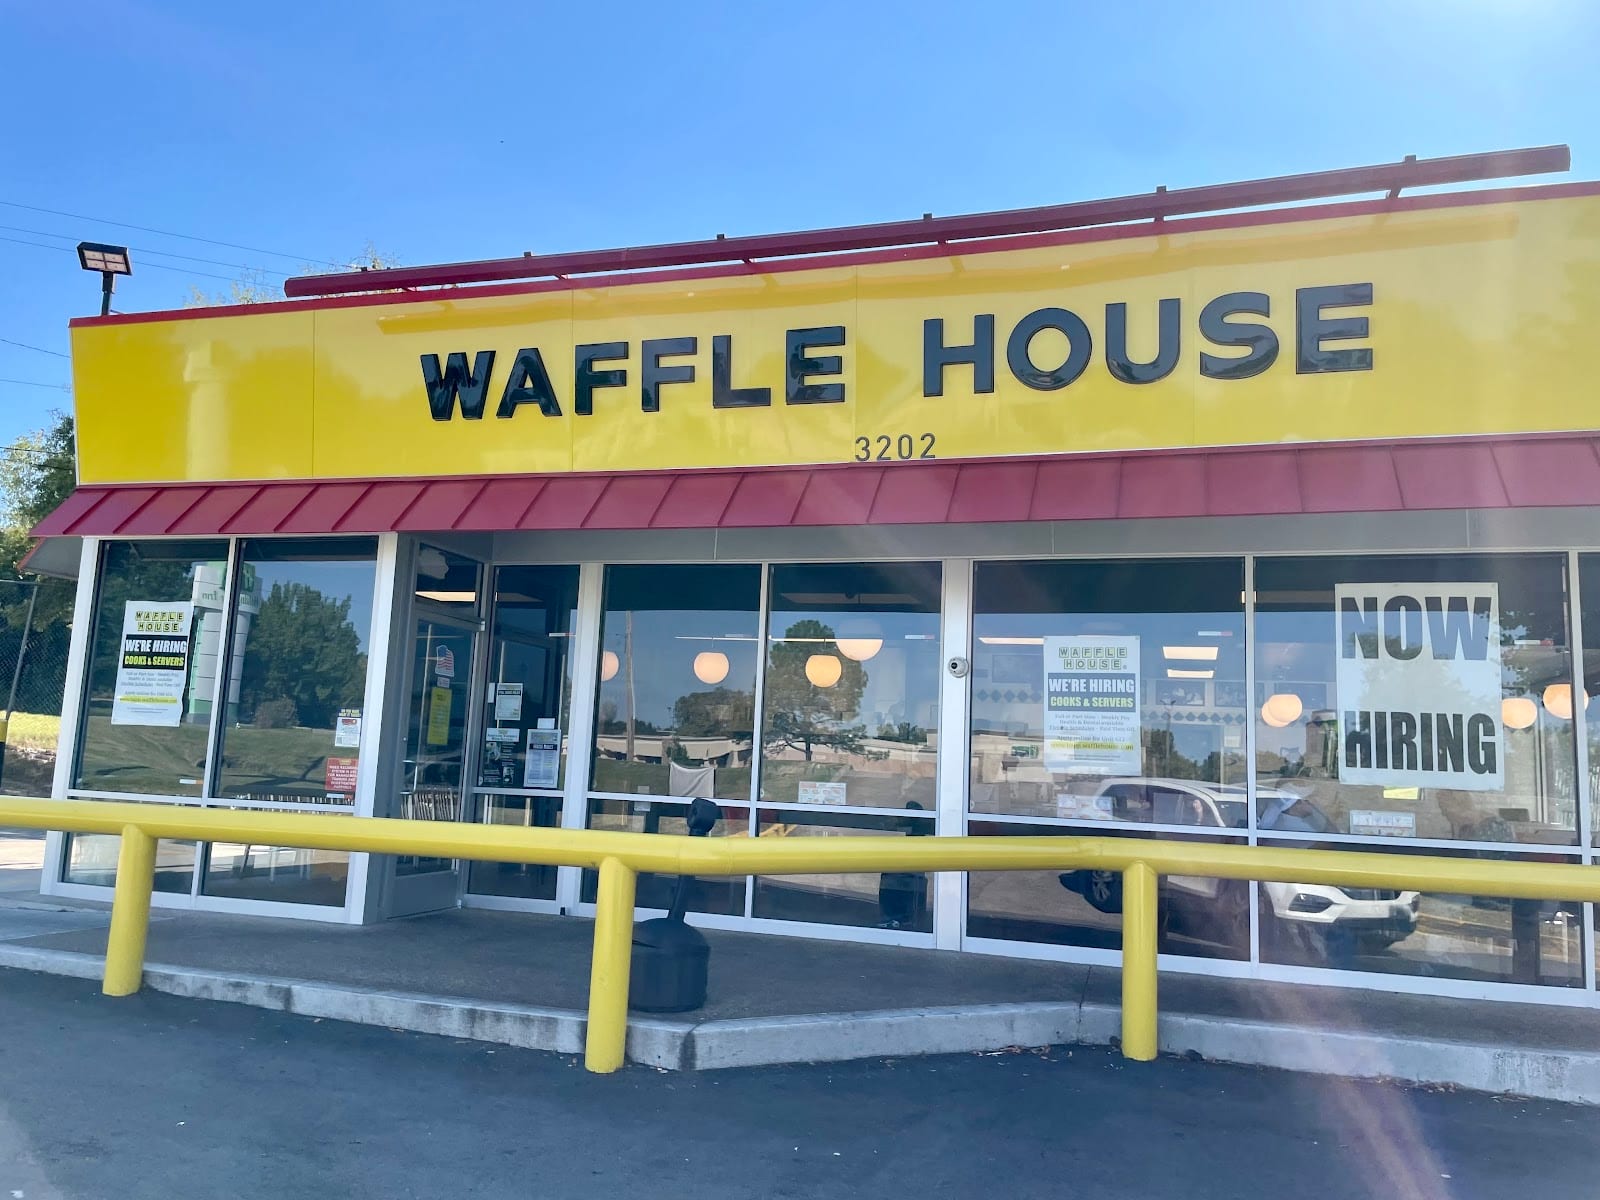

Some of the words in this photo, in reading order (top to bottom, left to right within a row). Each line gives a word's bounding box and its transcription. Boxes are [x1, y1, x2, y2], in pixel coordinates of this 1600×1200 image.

[420, 326, 846, 421] WAFFLE
[923, 283, 1373, 397] HOUSE
[855, 433, 936, 463] 3202
[134, 610, 185, 622] WAFFLE
[137, 622, 180, 632] HOUSE
[1341, 595, 1492, 661] NOW
[125, 639, 152, 653] WE'RE
[152, 640, 187, 654] HIRING
[1059, 647, 1127, 658] WAFFLE
[124, 655, 147, 665] COOKS
[153, 656, 185, 667] SERVERS
[1064, 659, 1121, 670] HOUSE
[1048, 678, 1087, 692] WE'RE
[1090, 679, 1135, 693] HIRING
[1050, 696, 1081, 707] COOKS
[1083, 698, 1090, 707] &
[1092, 697, 1134, 708] SERVERS
[1344, 711, 1497, 775] HIRING
